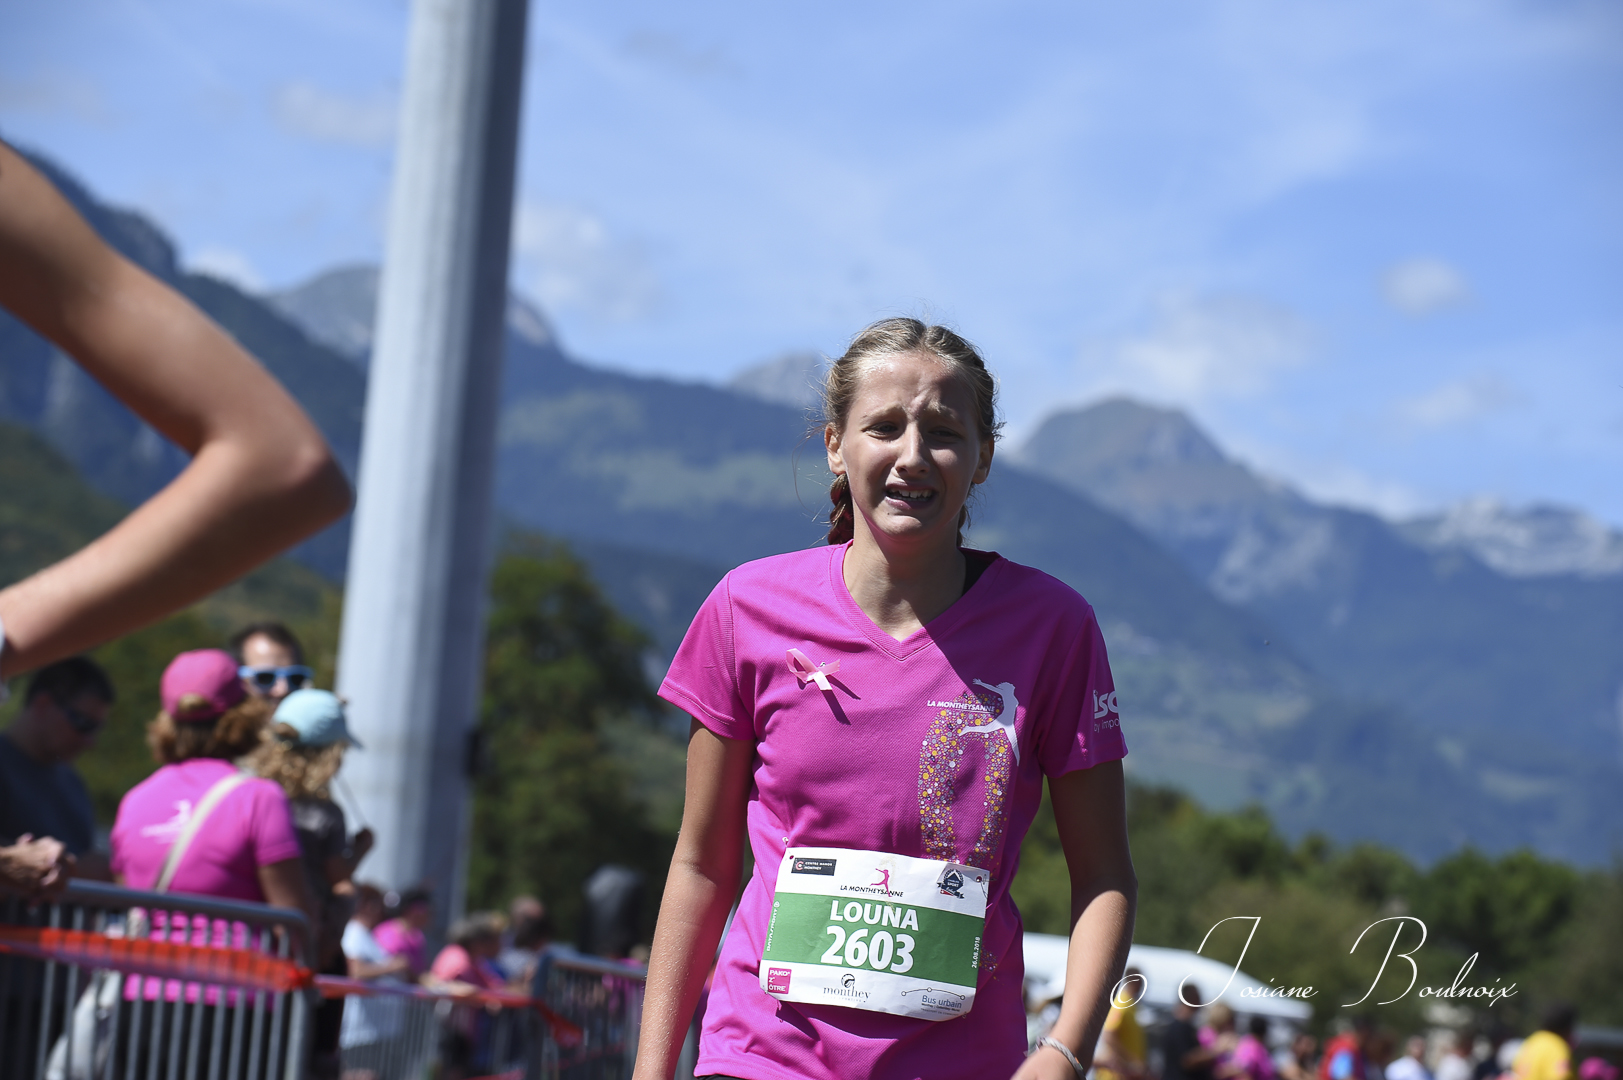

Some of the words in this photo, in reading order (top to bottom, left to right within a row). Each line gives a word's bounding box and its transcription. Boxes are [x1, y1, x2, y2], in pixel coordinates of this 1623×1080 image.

[937, 701, 995, 712] MONTHEYSANNE
[849, 886, 904, 898] MONTHEYSANNE
[830, 900, 919, 931] LOUNA
[766, 908, 778, 952] DATASPORT
[820, 925, 916, 973] 2603
[971, 936, 981, 969] 26.08.2018
[823, 984, 871, 1003] monthey
[921, 994, 936, 1005] Bus
[938, 998, 962, 1009] urbain
